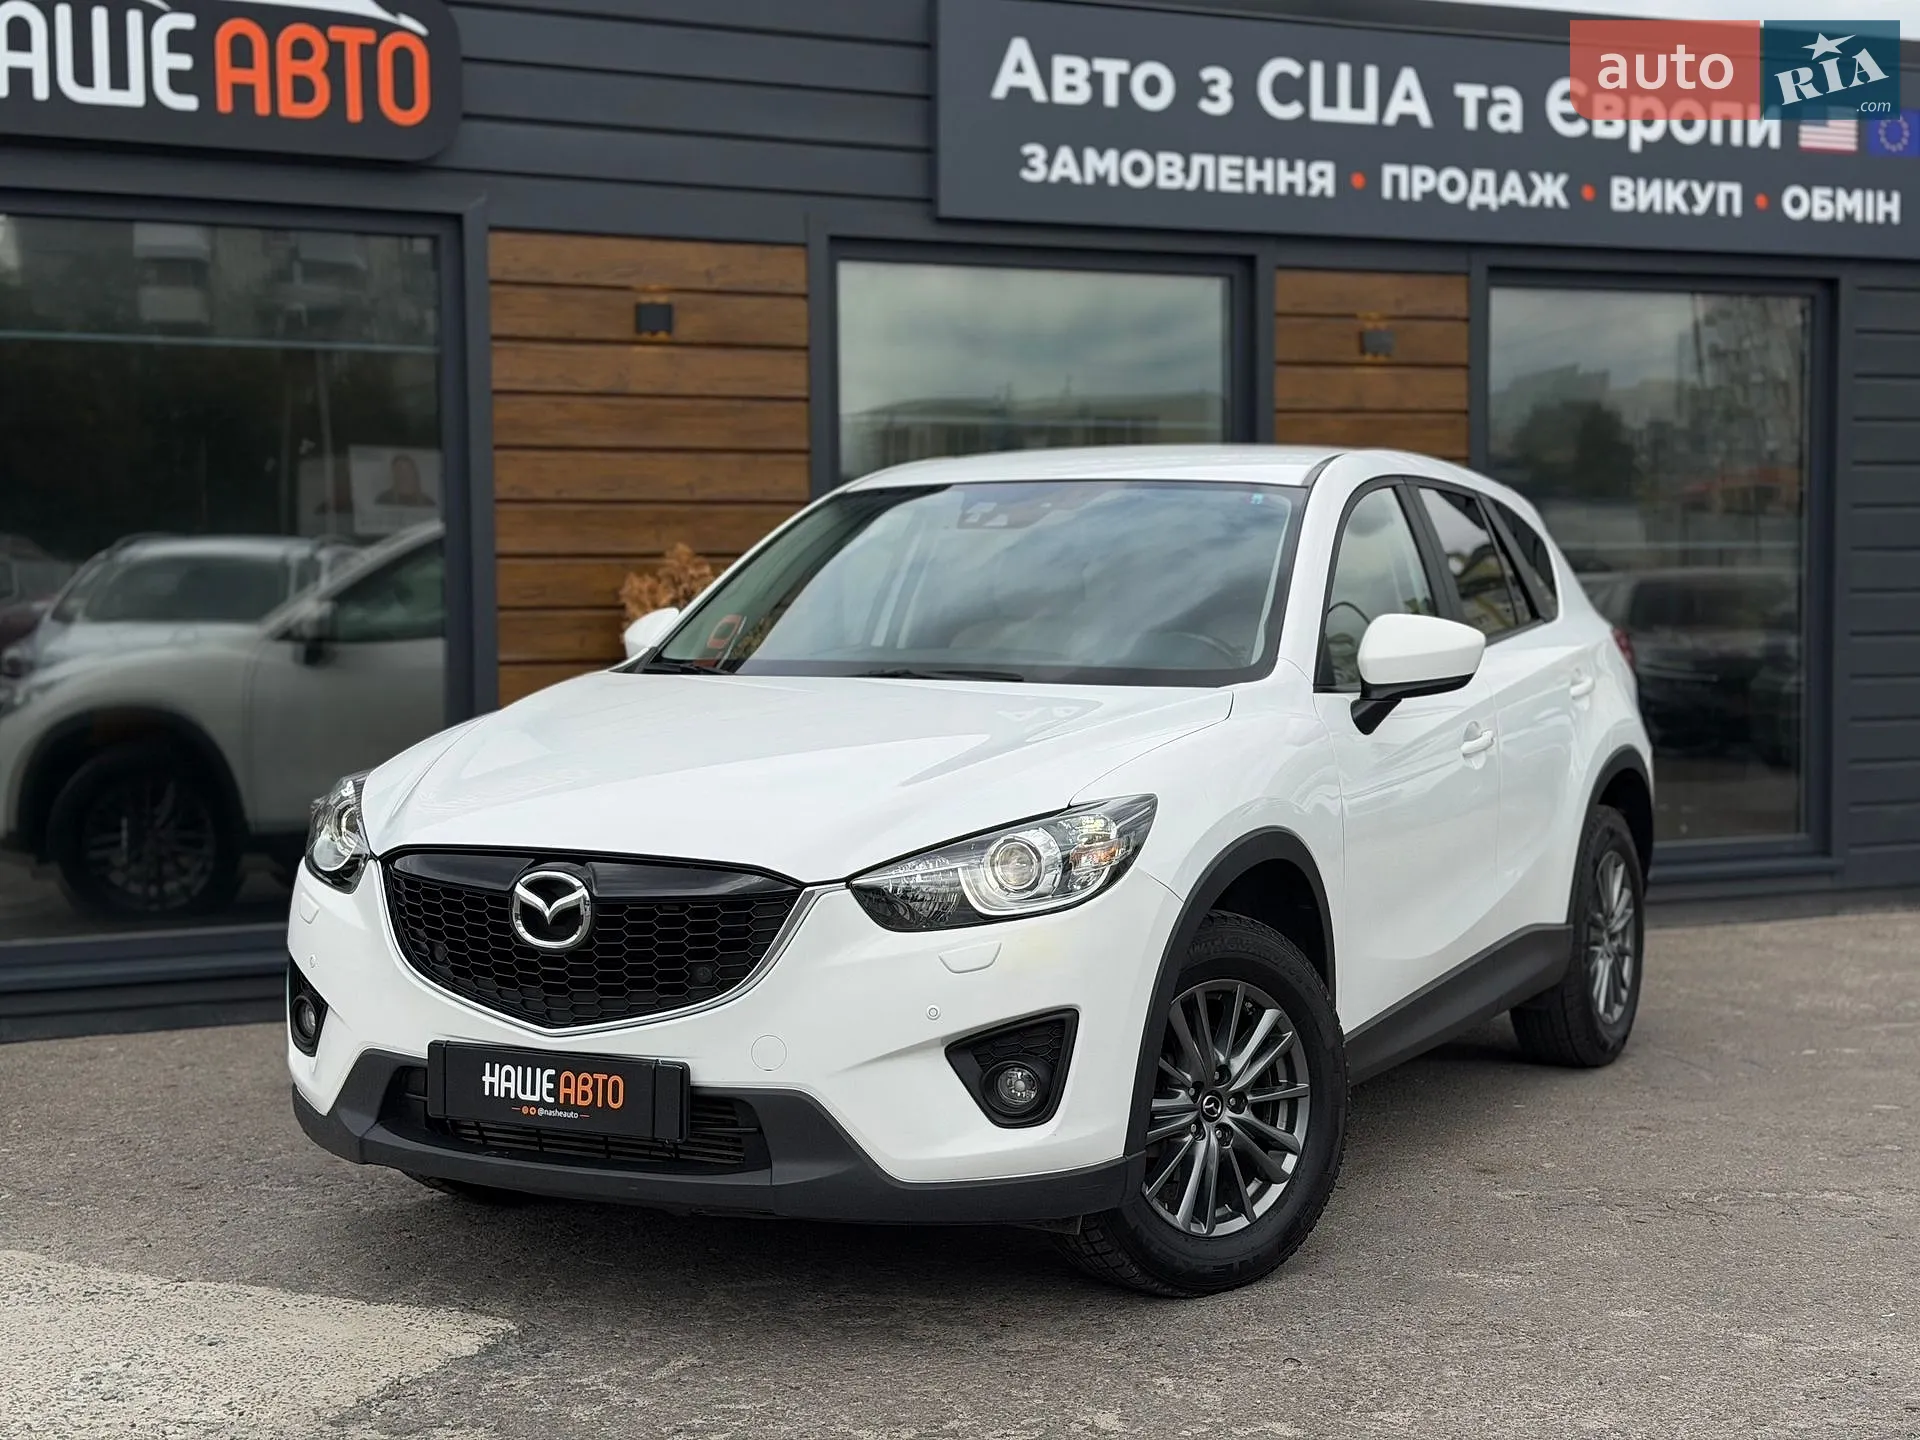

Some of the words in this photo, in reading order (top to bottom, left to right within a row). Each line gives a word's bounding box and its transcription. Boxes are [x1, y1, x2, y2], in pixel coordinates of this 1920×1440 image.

[214, 17, 432, 127] АВТО
[990, 36, 1177, 112] Авто
[1198, 66, 1234, 116] з
[1256, 57, 1434, 128] США
[1453, 82, 1523, 133] та
[1545, 76, 1781, 152] Європи
[1019, 143, 1336, 197] ЗАМОВЛЕННЯ
[1381, 163, 1570, 210] ПРОДАЖ
[1610, 176, 1743, 216] ВИКУП
[1781, 184, 1901, 224] ОБМІН
[482, 1062, 555, 1103] НАШЕ
[559, 1070, 624, 1109] АВТО
[537, 1107, 579, 1119] @nasheauto
